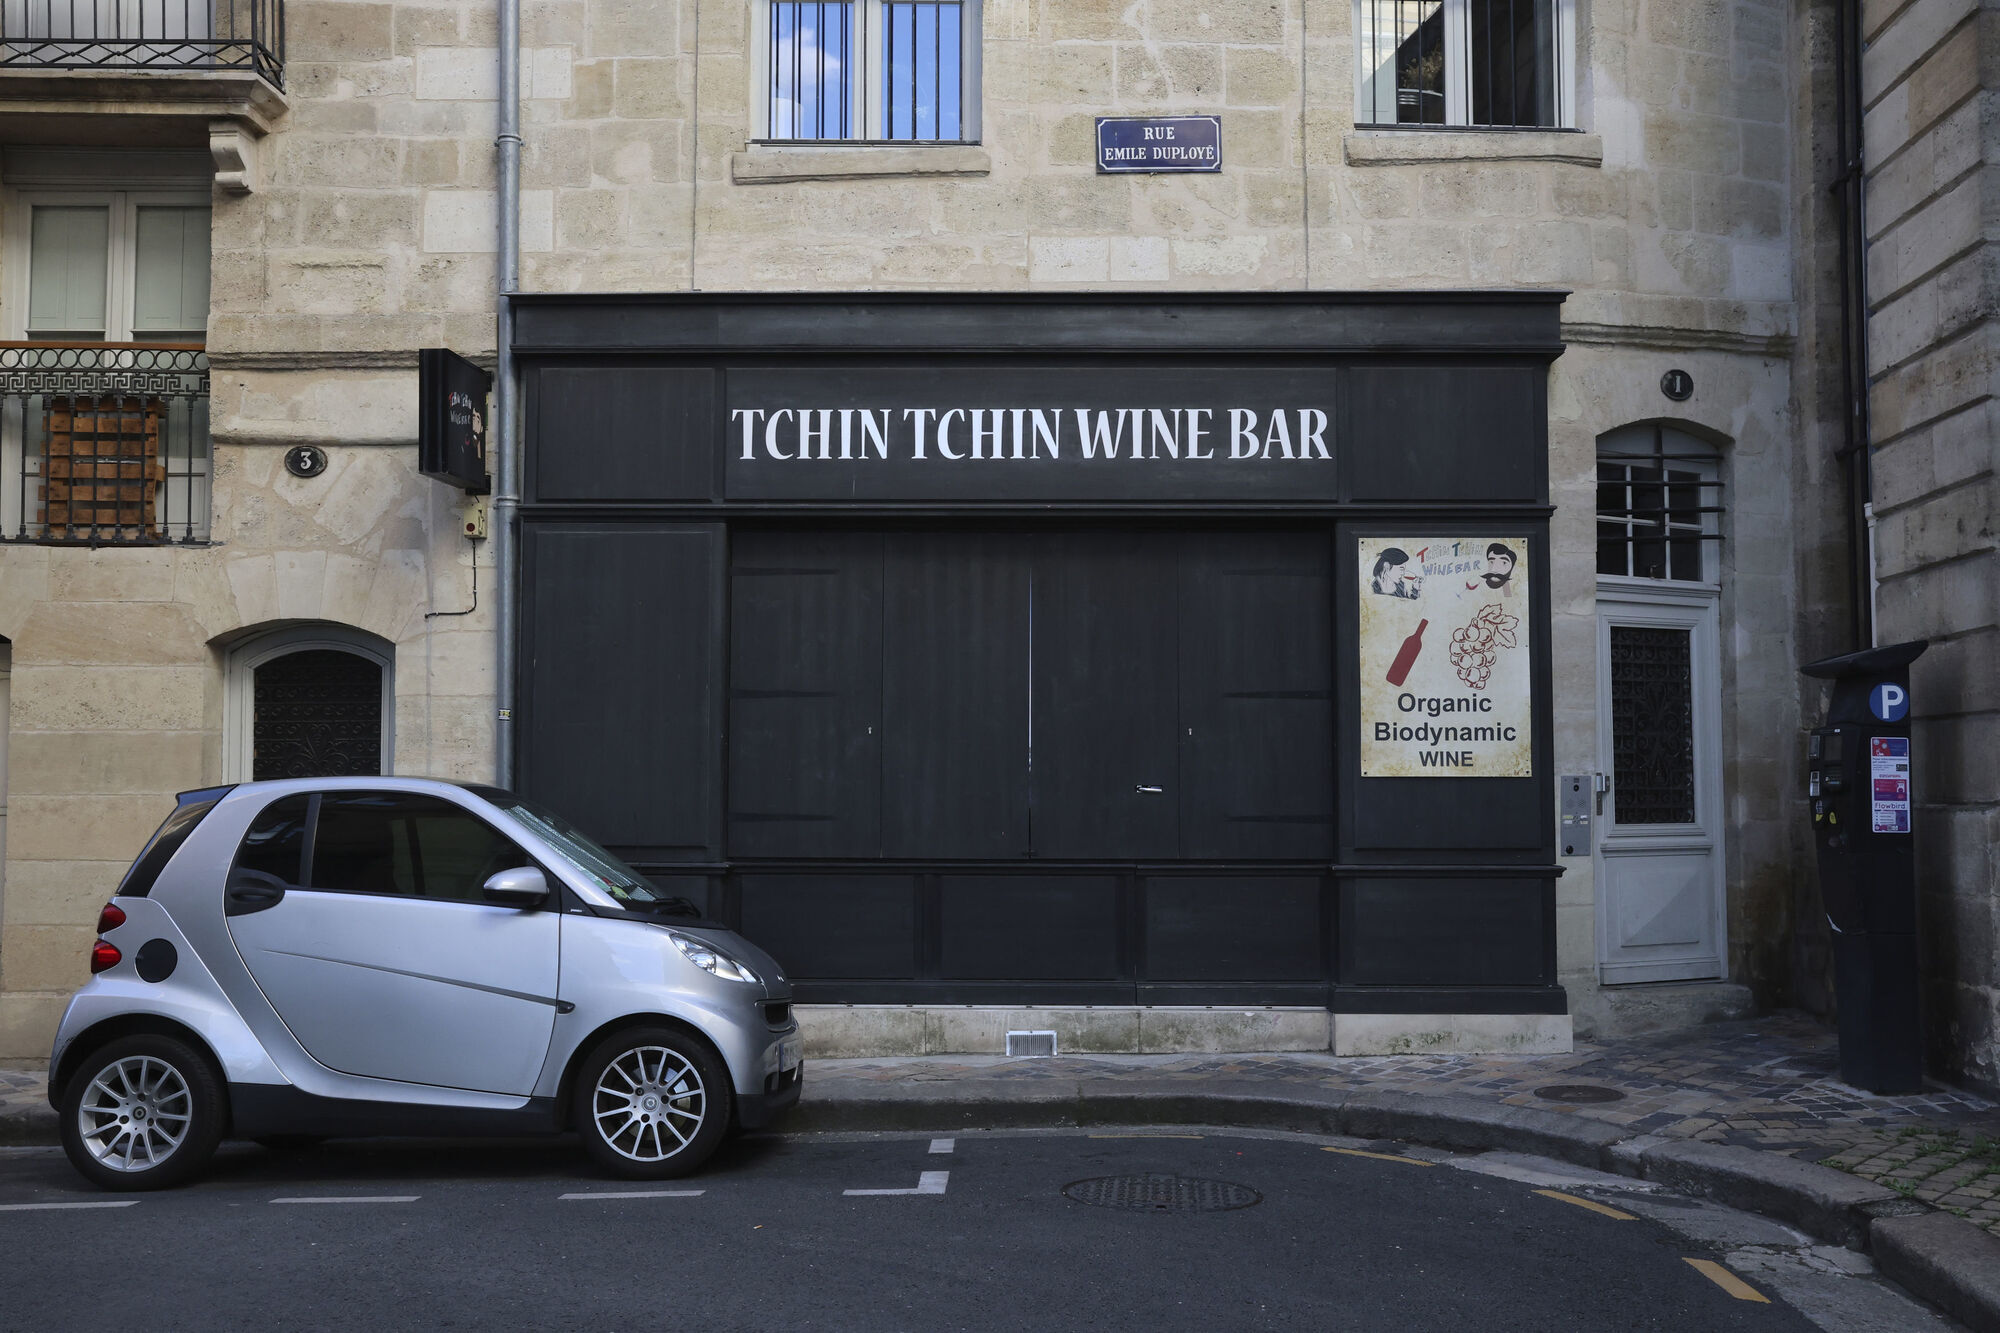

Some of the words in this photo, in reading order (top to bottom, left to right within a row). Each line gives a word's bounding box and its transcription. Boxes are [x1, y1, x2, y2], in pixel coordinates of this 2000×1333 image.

[1143, 126, 1175, 140] RUE
[1104, 147, 1147, 161] EMILE
[1152, 144, 1215, 160] DUPLOYÉ
[732, 408, 892, 460] TCHIN
[904, 408, 1063, 460] TCHIN
[1074, 408, 1214, 460] WINE
[1227, 408, 1333, 460] BAR
[300, 451, 312, 470] 3
[1398, 692, 1492, 718] Organic
[1881, 685, 1904, 719] P
[1374, 721, 1517, 747] Biodynamic
[1418, 750, 1474, 768] WINE
